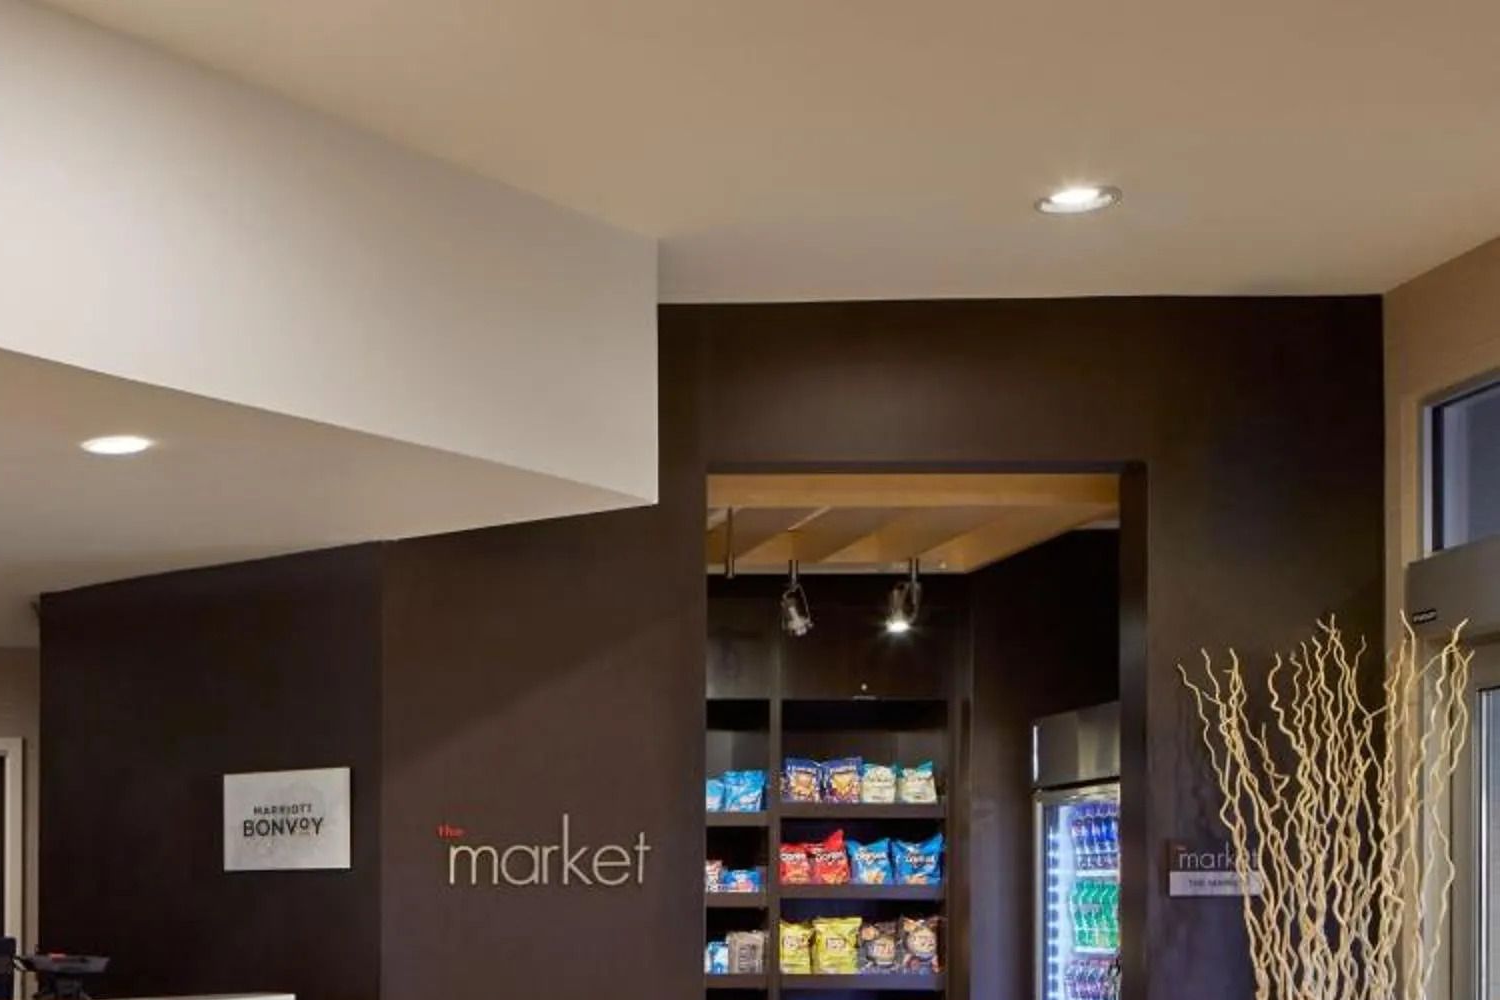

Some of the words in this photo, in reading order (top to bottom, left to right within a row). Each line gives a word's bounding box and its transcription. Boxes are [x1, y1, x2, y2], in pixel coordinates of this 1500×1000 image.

[253, 803, 312, 815] MARRIOTT
[243, 817, 324, 837] BONVOY
[449, 813, 651, 886] market
[1179, 841, 1260, 869] markt
